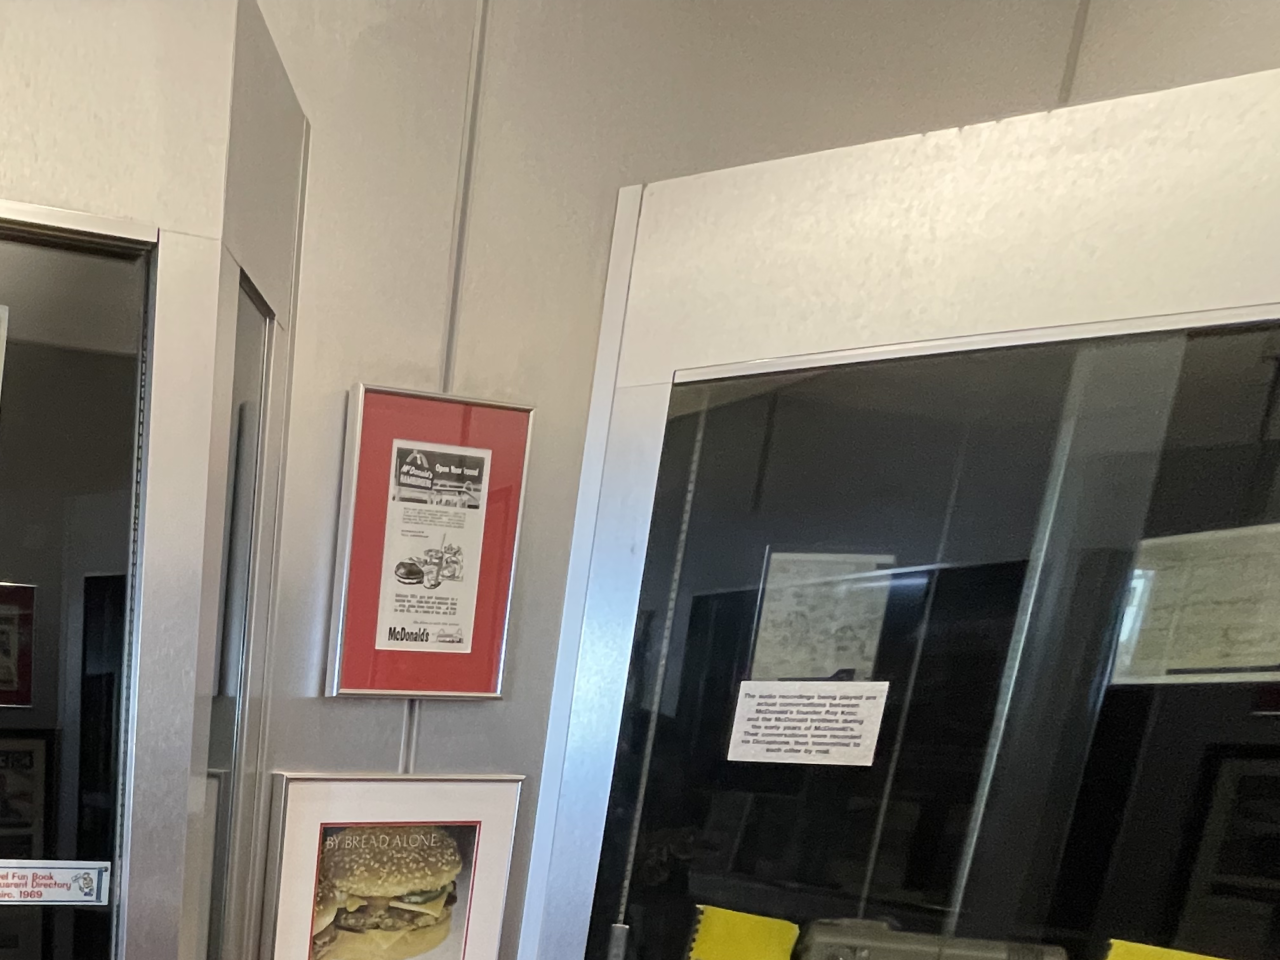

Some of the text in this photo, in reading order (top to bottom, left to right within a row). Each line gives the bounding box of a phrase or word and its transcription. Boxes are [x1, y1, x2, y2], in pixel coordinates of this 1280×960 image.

[388, 626, 429, 642] McDonald's
[326, 834, 341, 849] BY
[345, 834, 389, 849] BREAD
[11, 872, 28, 880] Fun
[31, 872, 54, 881] Book
[31, 880, 72, 891] Directory
[19, 890, 43, 899] 1969
